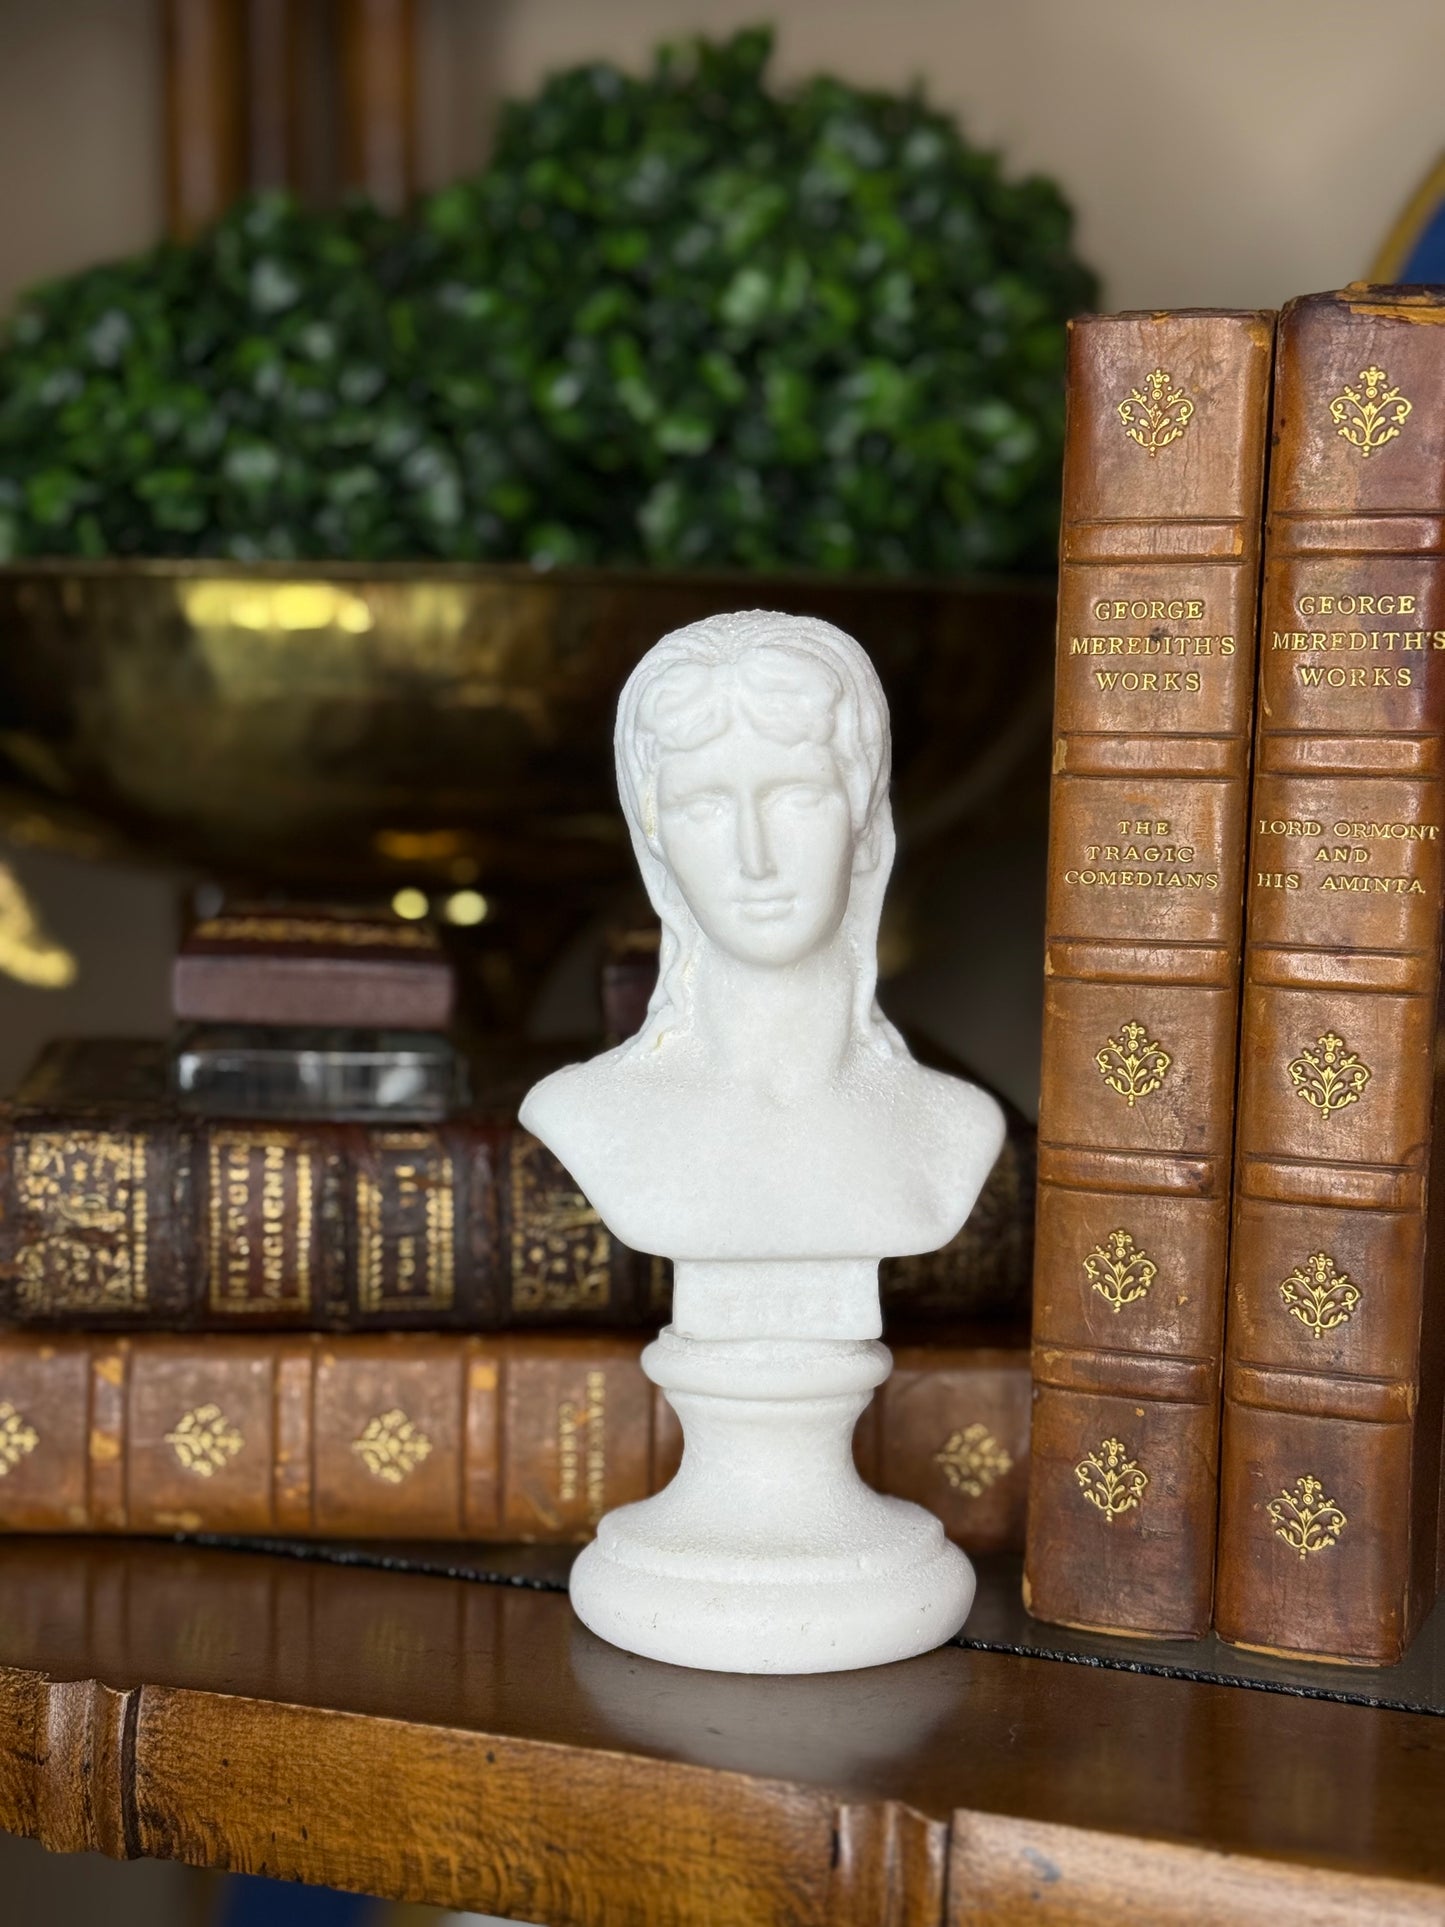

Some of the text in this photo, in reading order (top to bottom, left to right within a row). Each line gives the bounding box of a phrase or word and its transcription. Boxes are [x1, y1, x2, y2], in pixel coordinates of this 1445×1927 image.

[1095, 600, 1204, 621] GEORGE
[1299, 595, 1416, 615] GEORGE
[1069, 636, 1236, 656] MEREDITH'S
[1271, 630, 1445, 651] MEREDITH'S
[1096, 672, 1201, 692] WORKS
[1300, 667, 1412, 688] WORKS
[1118, 820, 1170, 836] THE
[1259, 820, 1440, 840] LORD ORMONT
[1086, 846, 1195, 863] TRAGIC
[1314, 848, 1369, 863] AND
[1065, 870, 1218, 890] COMEDIANS
[1257, 872, 1426, 895] HIS AMINTA
